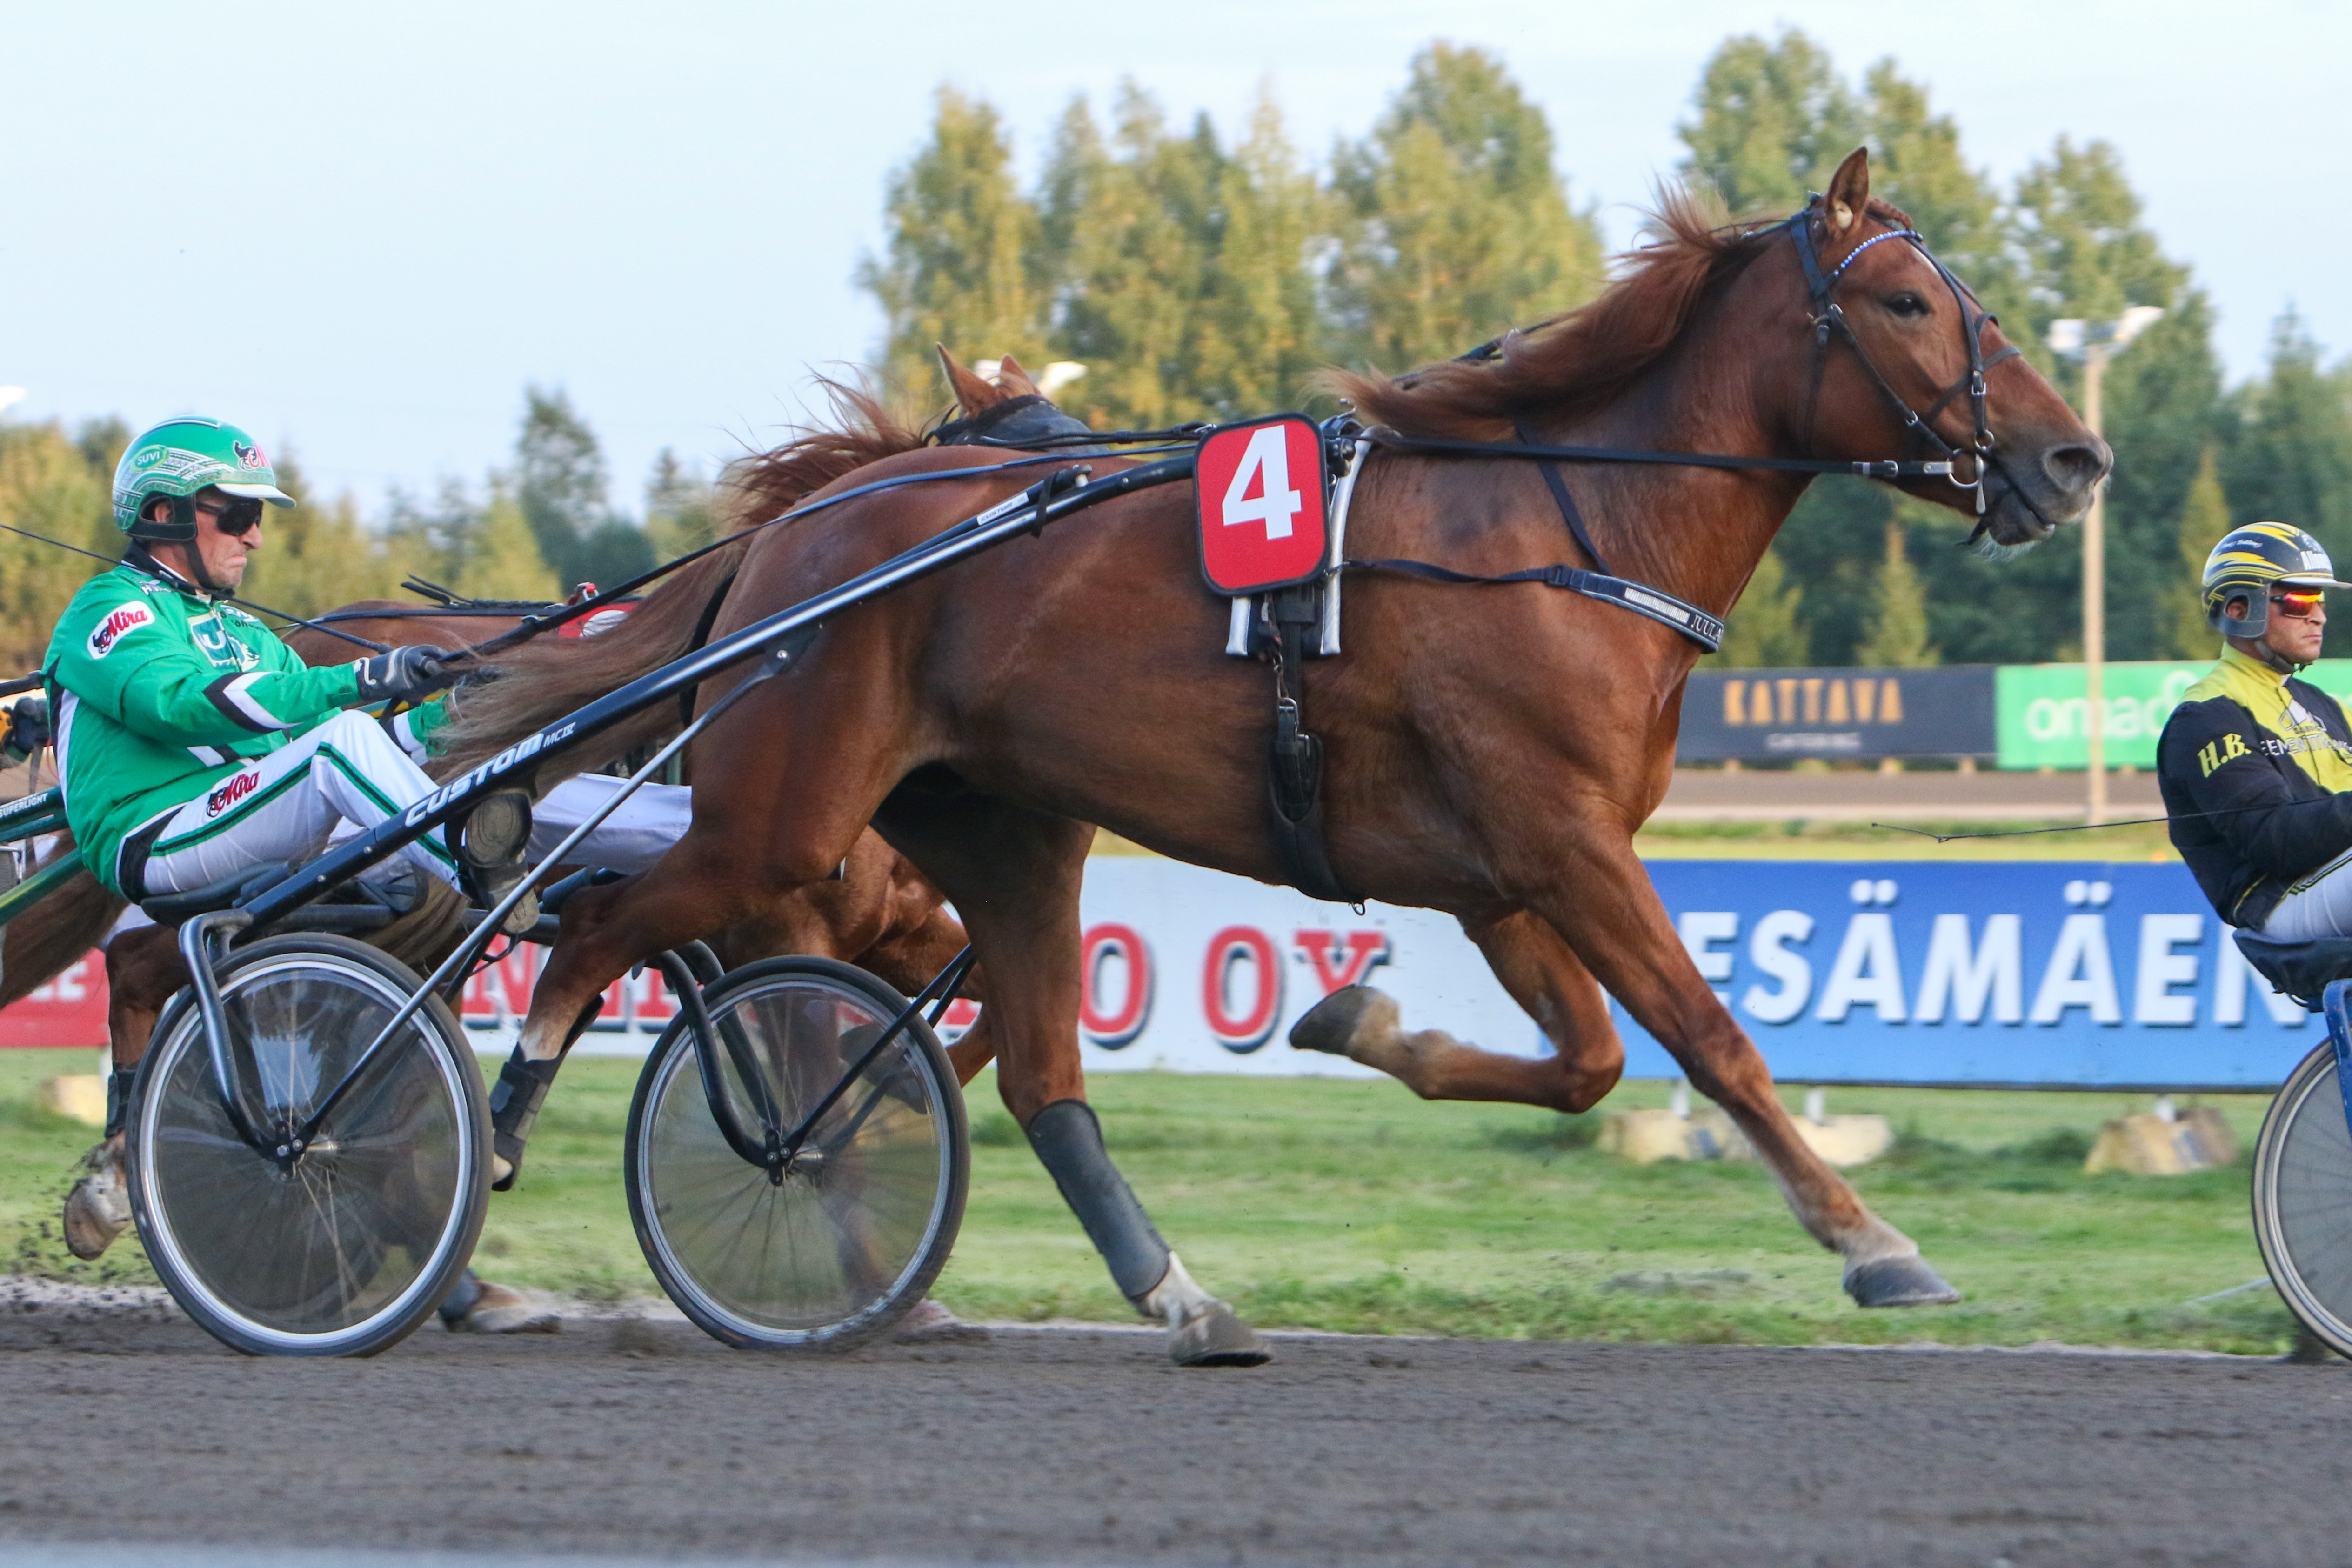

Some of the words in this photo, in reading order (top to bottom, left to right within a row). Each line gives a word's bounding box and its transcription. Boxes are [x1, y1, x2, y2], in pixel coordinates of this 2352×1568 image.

[137, 450, 160, 465] SUVI
[1222, 424, 1302, 540] 4
[101, 610, 148, 646] Mira
[2197, 733, 2252, 778] H.B.
[214, 771, 260, 811] Mira
[404, 733, 545, 827] CUSTOM
[0, 793, 48, 818] SUPERLIGHT
[1598, 879, 2306, 1026] ESÄMÄEN
